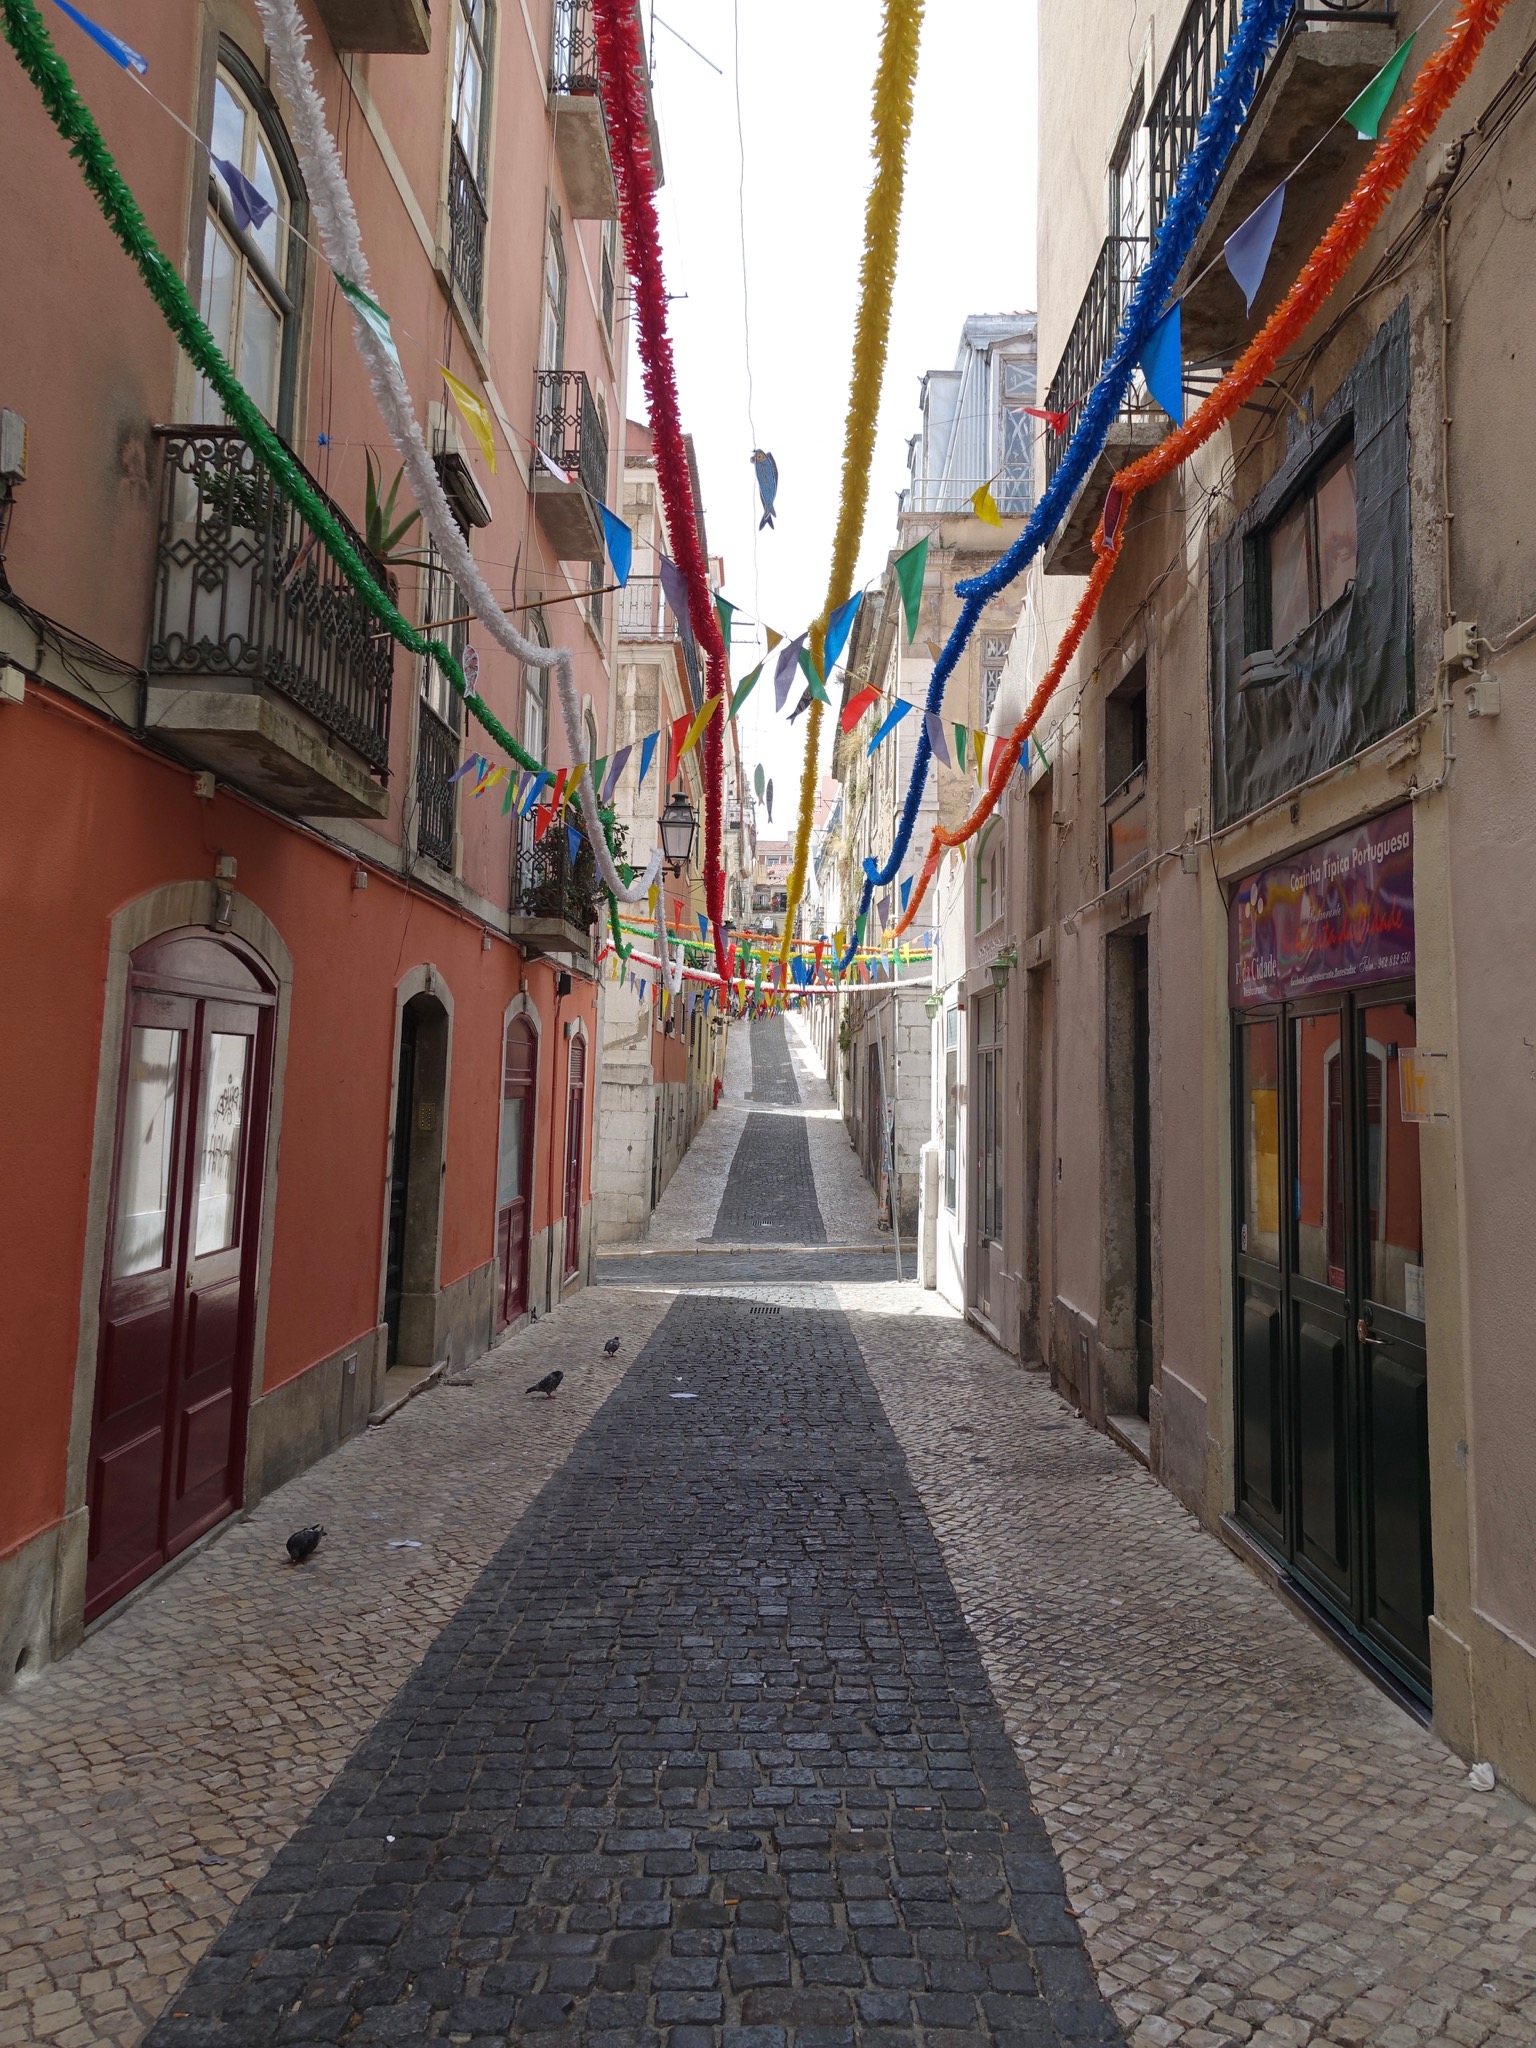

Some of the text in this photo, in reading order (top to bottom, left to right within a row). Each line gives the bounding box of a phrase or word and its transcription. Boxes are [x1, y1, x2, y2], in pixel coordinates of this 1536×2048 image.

[1290, 831, 1410, 893] Cozinha Típica Portuguesa
[1241, 959, 1250, 983] da
[1251, 953, 1278, 981] Cidade
[1388, 955, 1400, 967] 832
[1400, 951, 1412, 965] 550
